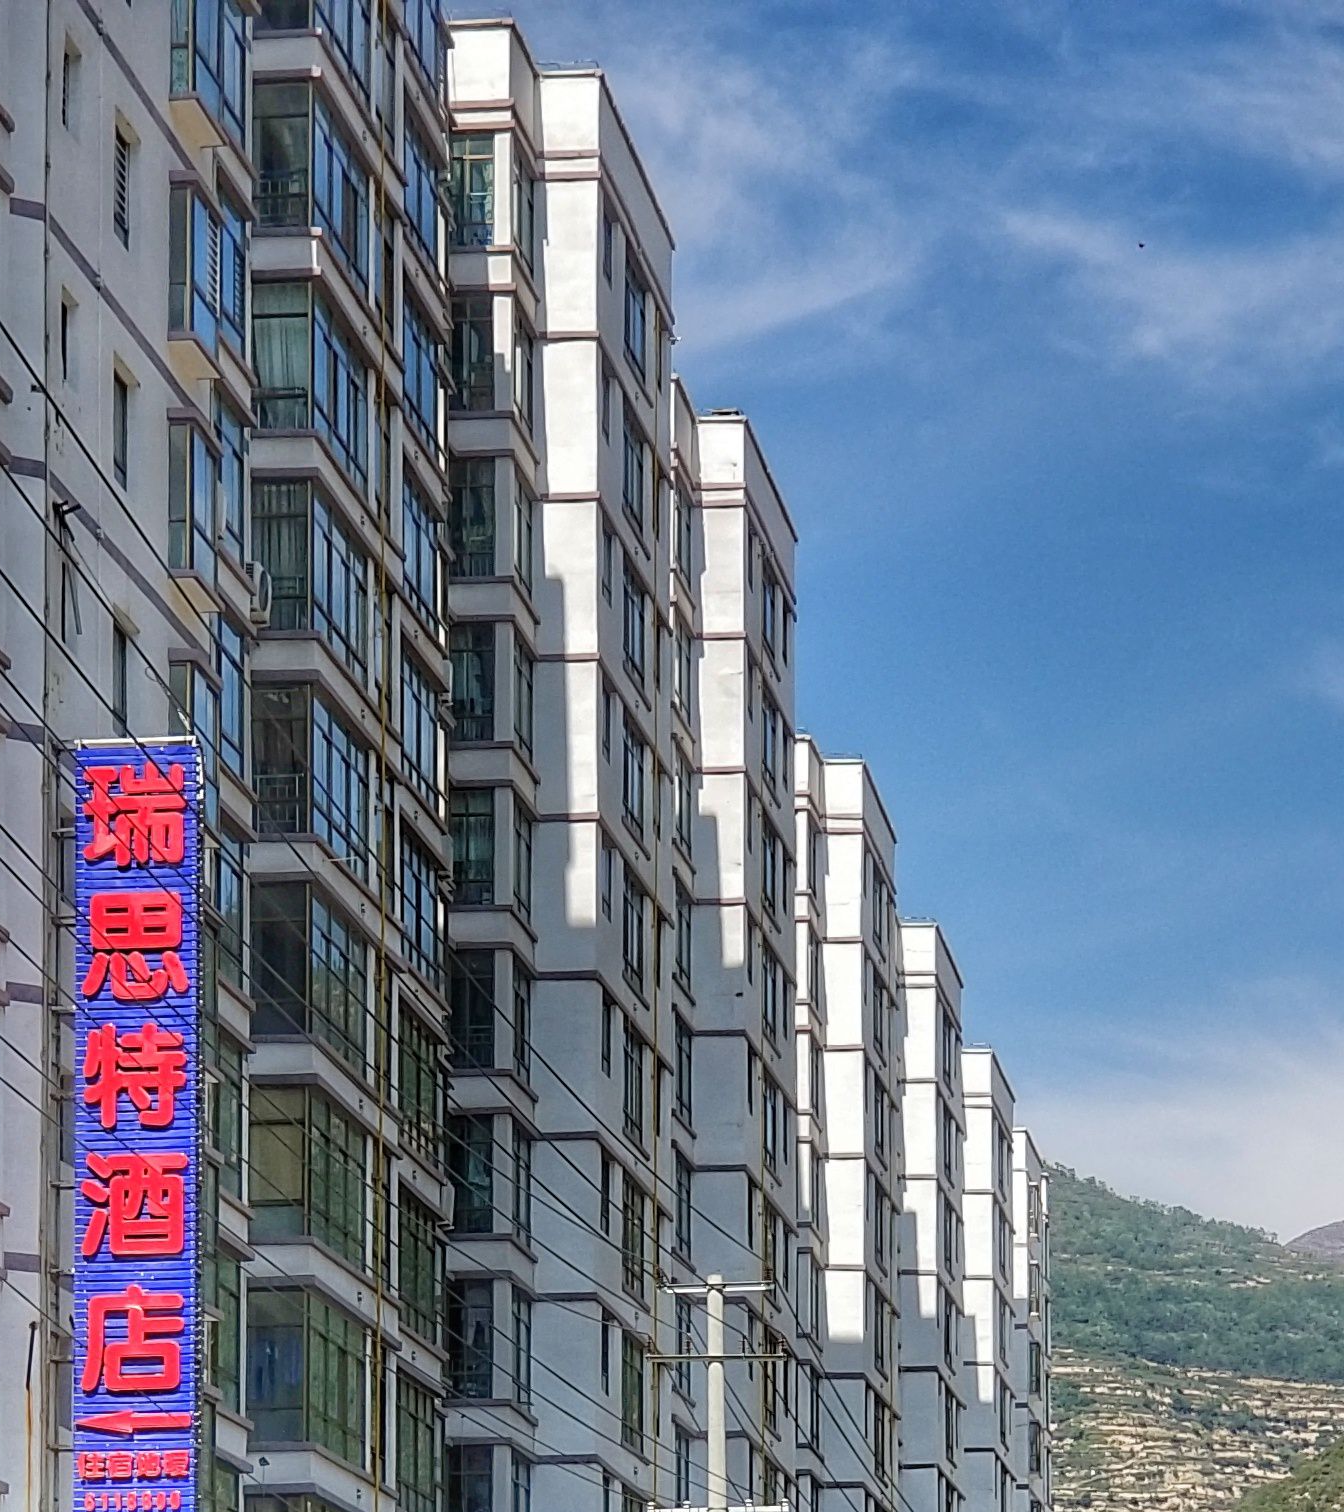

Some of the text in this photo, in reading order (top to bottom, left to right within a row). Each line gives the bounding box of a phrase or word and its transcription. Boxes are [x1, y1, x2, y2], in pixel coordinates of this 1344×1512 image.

[81, 761, 187, 1391] 瑞思特酒店
